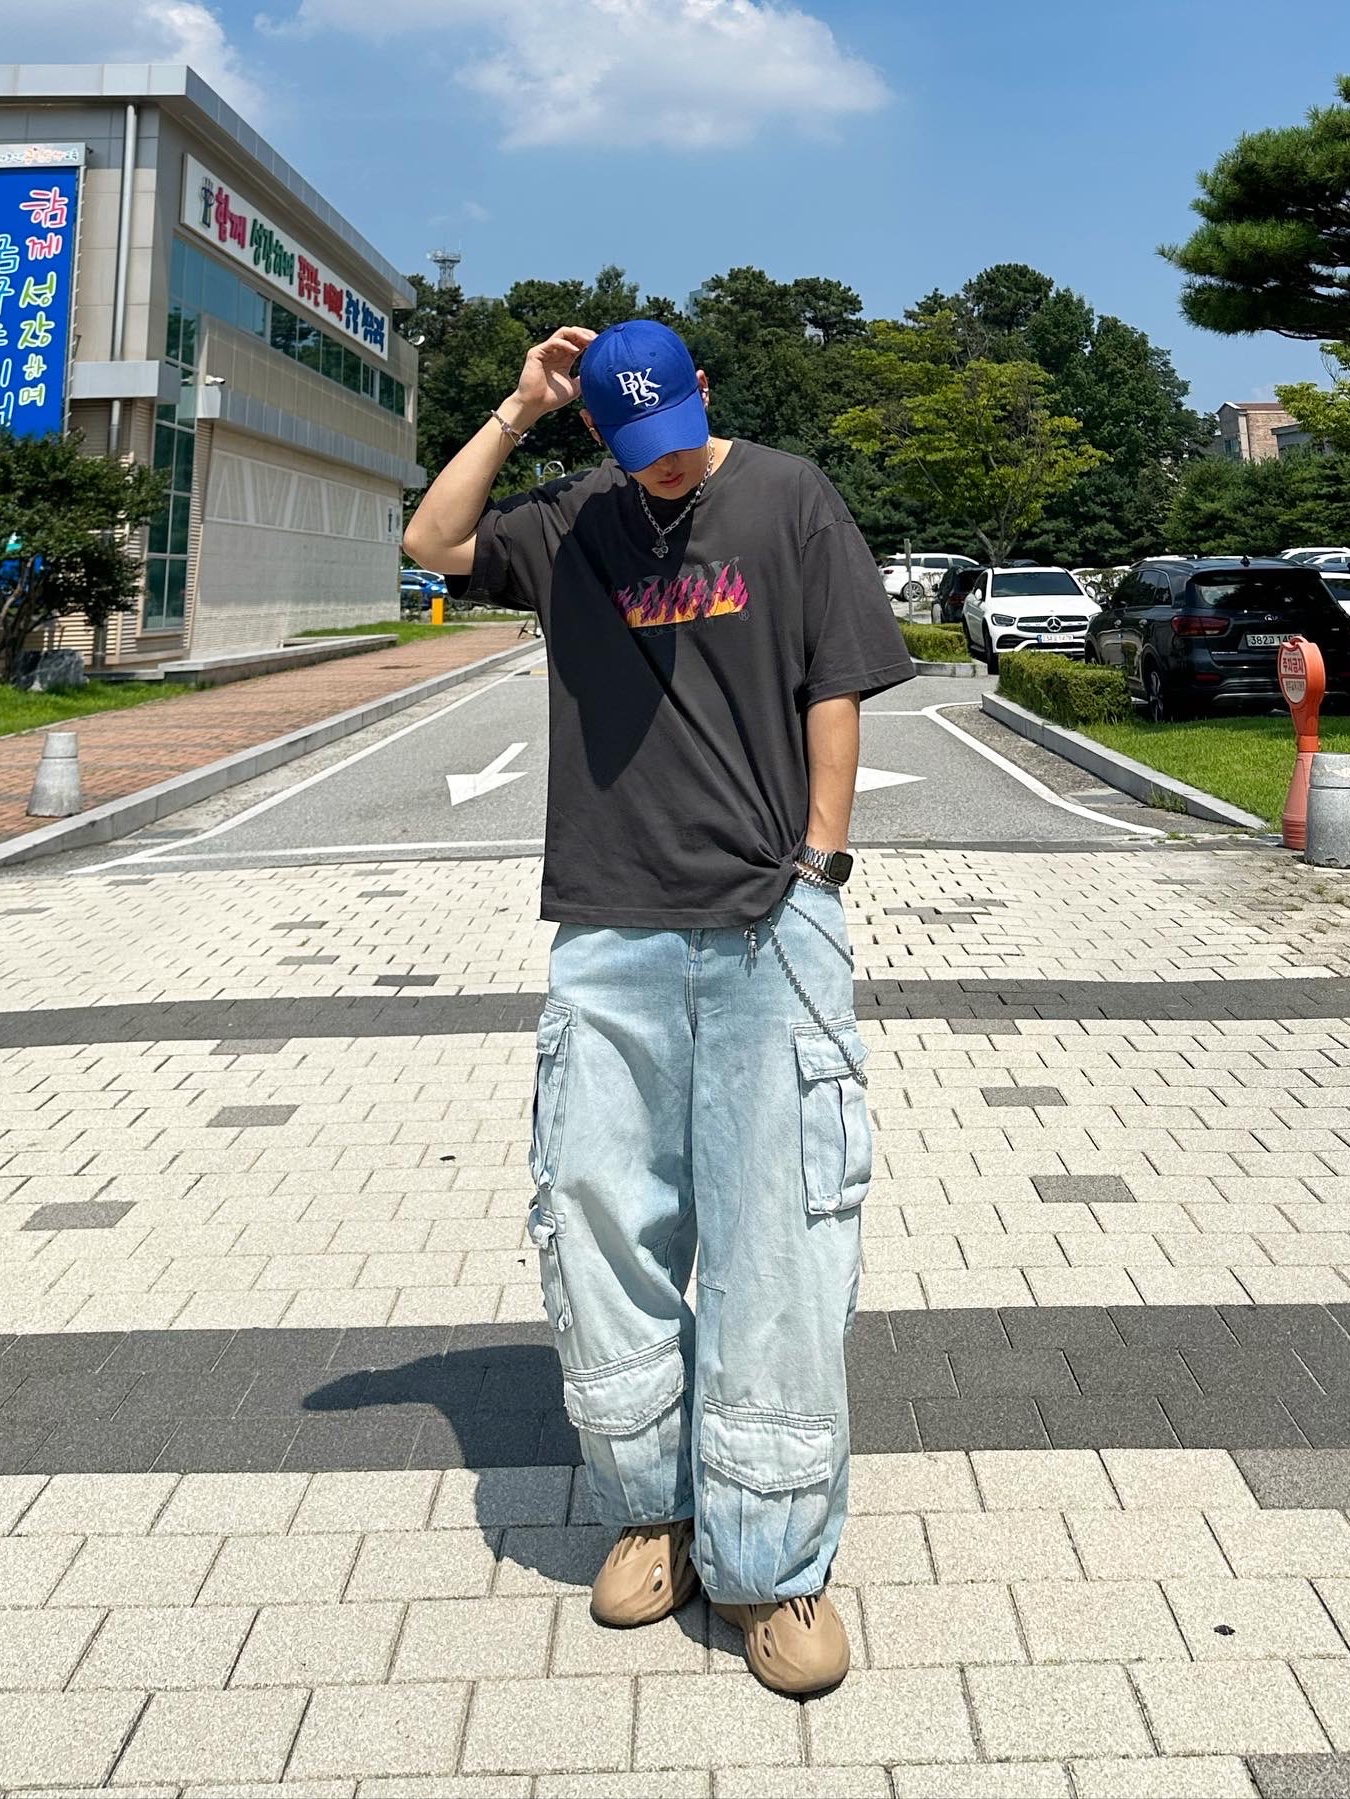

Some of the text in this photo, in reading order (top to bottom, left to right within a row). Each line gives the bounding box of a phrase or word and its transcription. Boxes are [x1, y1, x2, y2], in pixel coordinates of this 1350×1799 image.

[19, 187, 69, 260] 함께
[215, 186, 247, 249] 함께
[249, 218, 294, 285] 성장하며
[18, 271, 56, 406] 성장하며
[1283, 657, 1304, 673] 주차금지
